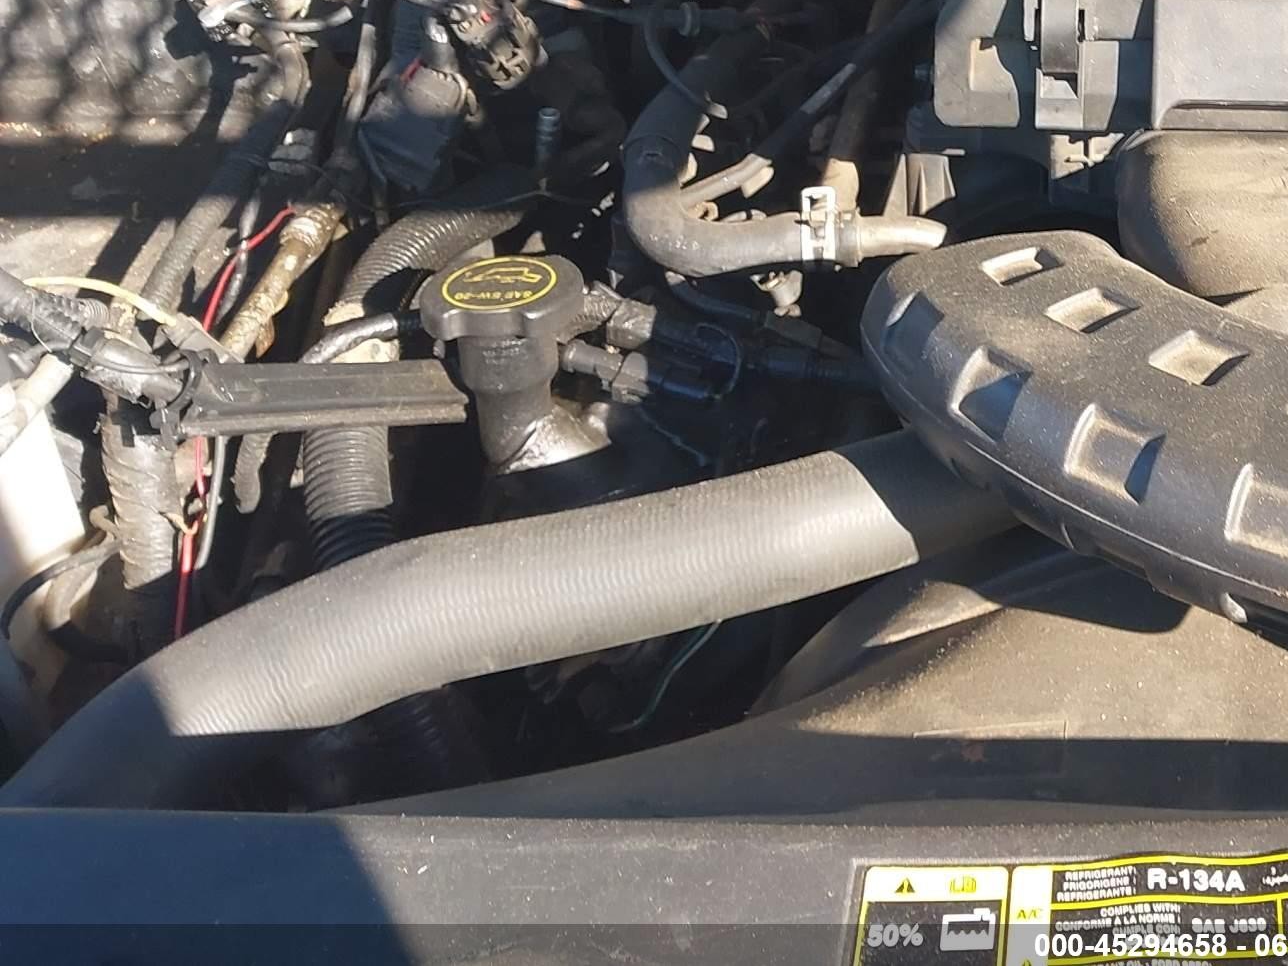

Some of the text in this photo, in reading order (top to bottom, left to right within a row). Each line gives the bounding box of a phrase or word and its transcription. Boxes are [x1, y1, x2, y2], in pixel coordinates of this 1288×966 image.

[1147, 867, 1246, 892] R-134A
[1099, 902, 1151, 917] COMPLIES
[1055, 917, 1112, 932] CONFORME
[1123, 914, 1137, 926] LA
[1138, 913, 1175, 925] NORME
[1191, 917, 1226, 933] SAE
[867, 922, 924, 948] 50%
